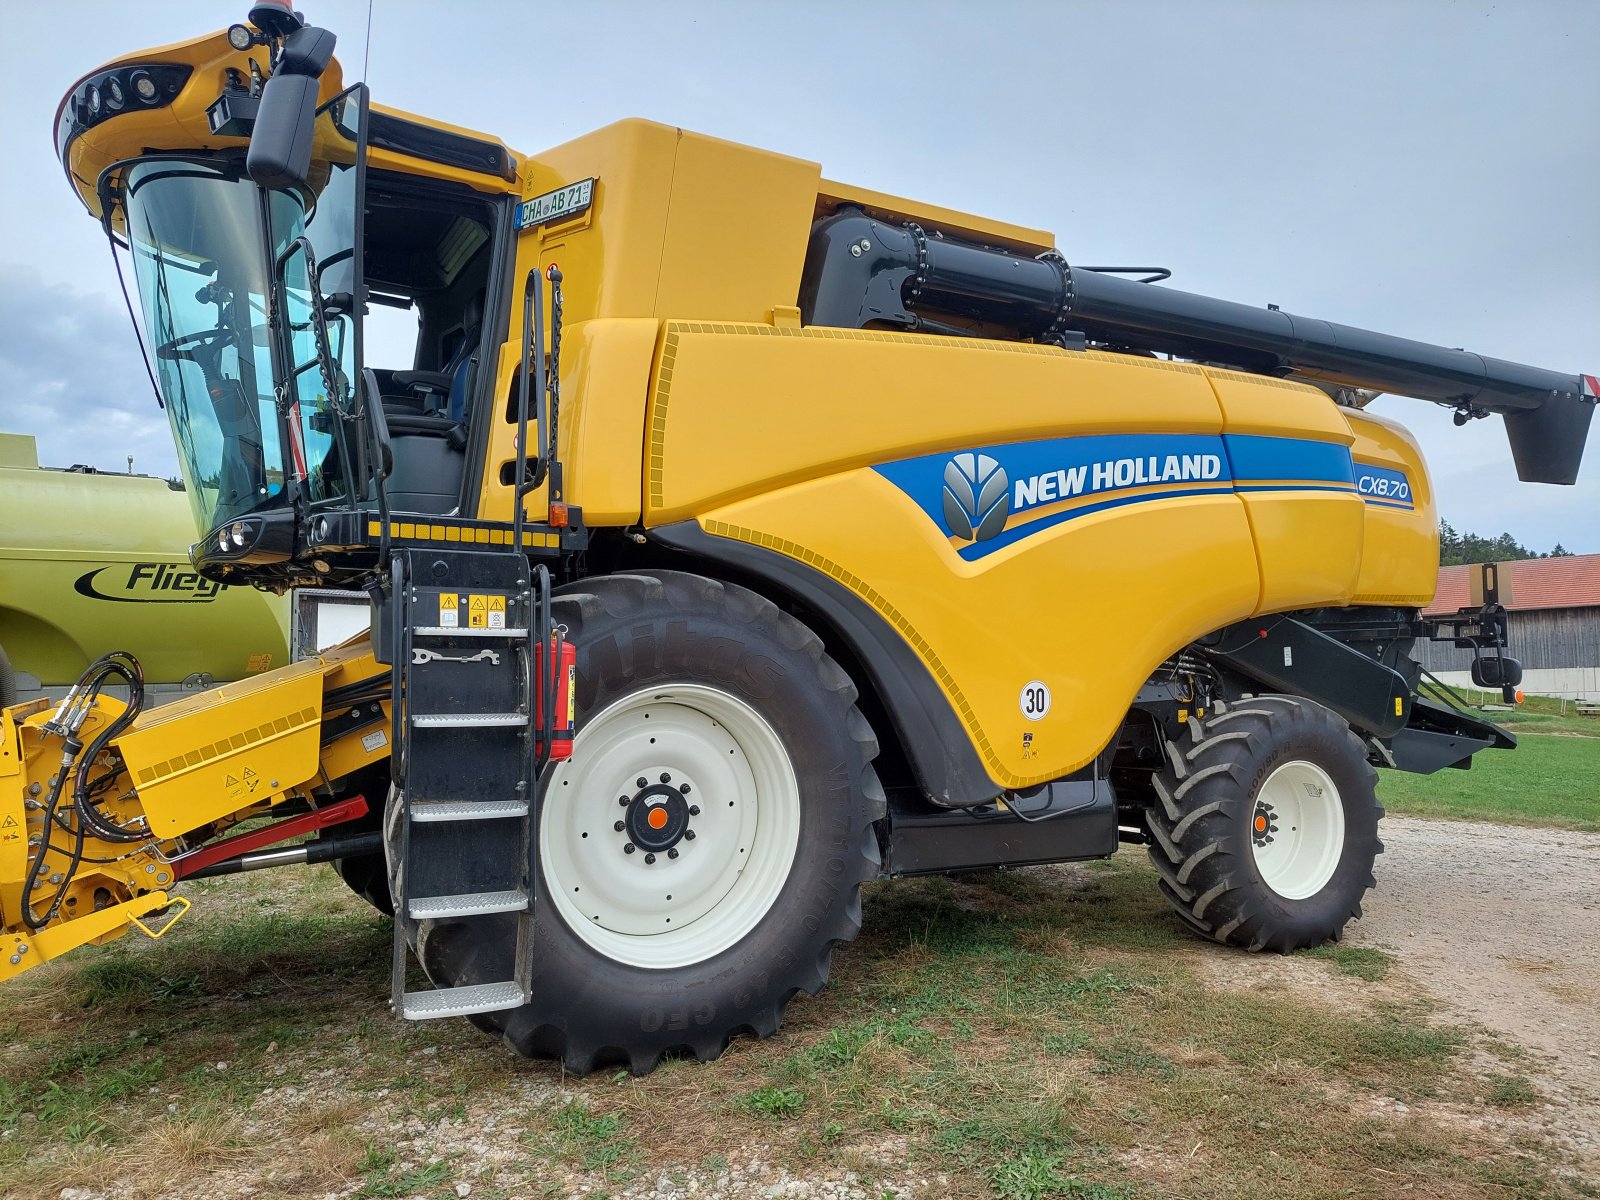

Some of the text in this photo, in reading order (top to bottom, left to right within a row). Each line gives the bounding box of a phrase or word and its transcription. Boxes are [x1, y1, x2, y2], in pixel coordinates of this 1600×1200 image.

[522, 200, 542, 222] CHA
[550, 192, 566, 213] AB
[567, 185, 582, 207] 71
[1014, 454, 1221, 508] NEW HOLLAND
[1358, 475, 1409, 499] CX8.70
[125, 563, 229, 598] Flieg
[1025, 687, 1045, 714] 30
[638, 998, 718, 1033] CFO
